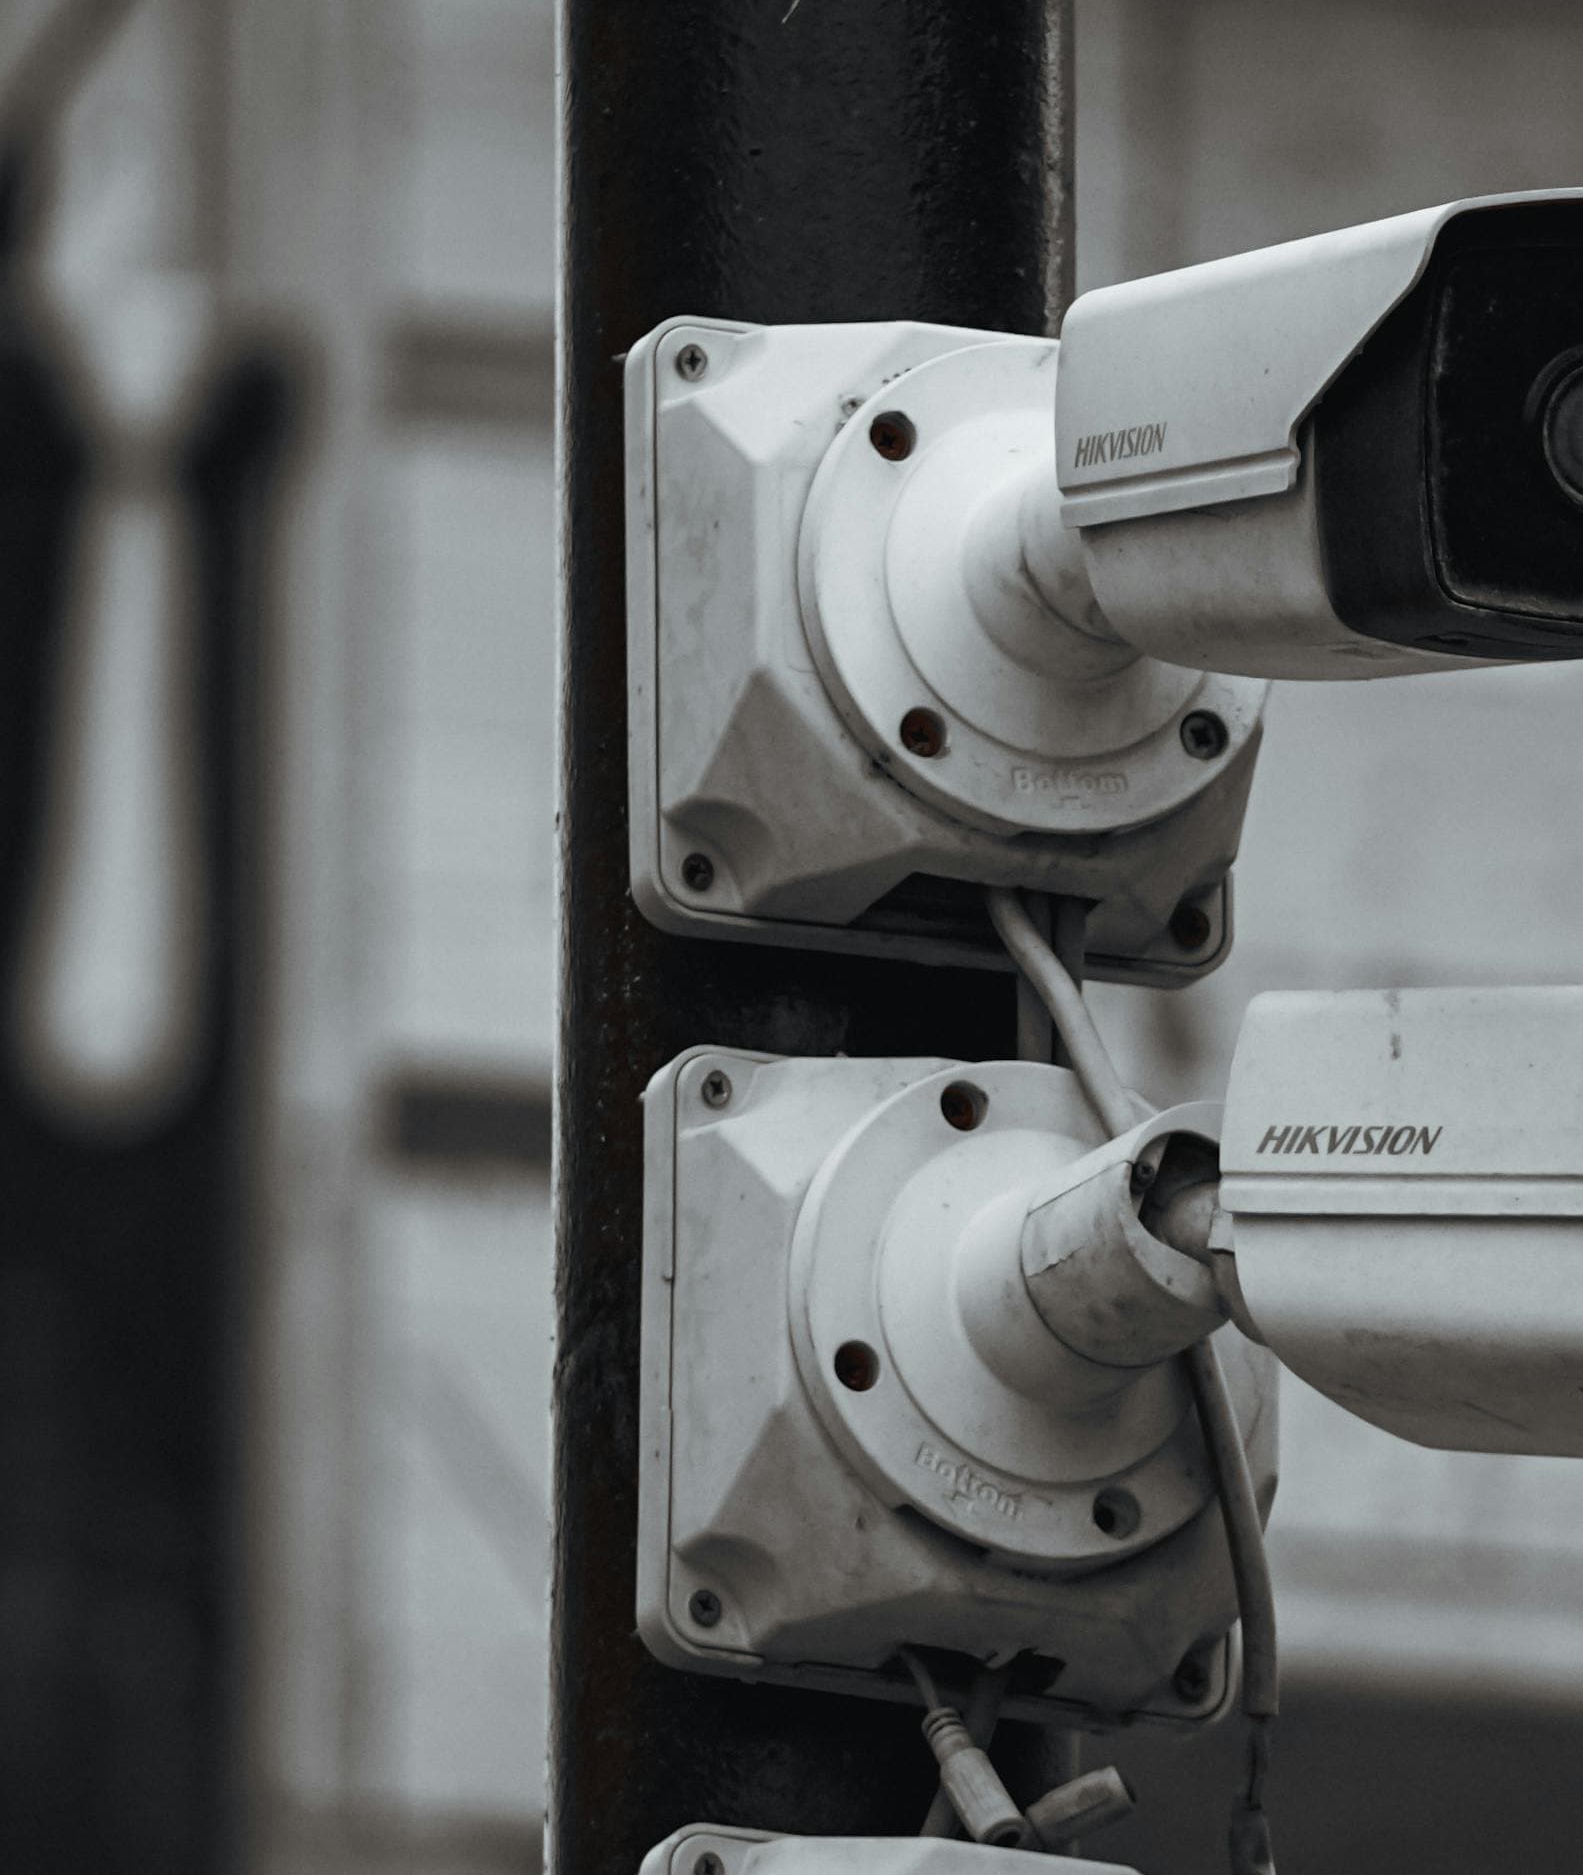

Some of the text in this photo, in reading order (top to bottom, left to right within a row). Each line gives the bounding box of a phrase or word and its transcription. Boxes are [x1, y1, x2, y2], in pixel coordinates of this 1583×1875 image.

[1074, 421, 1168, 468] HIKVISION
[1011, 768, 1128, 794] Bottom
[1256, 1125, 1443, 1155] HIKVISION
